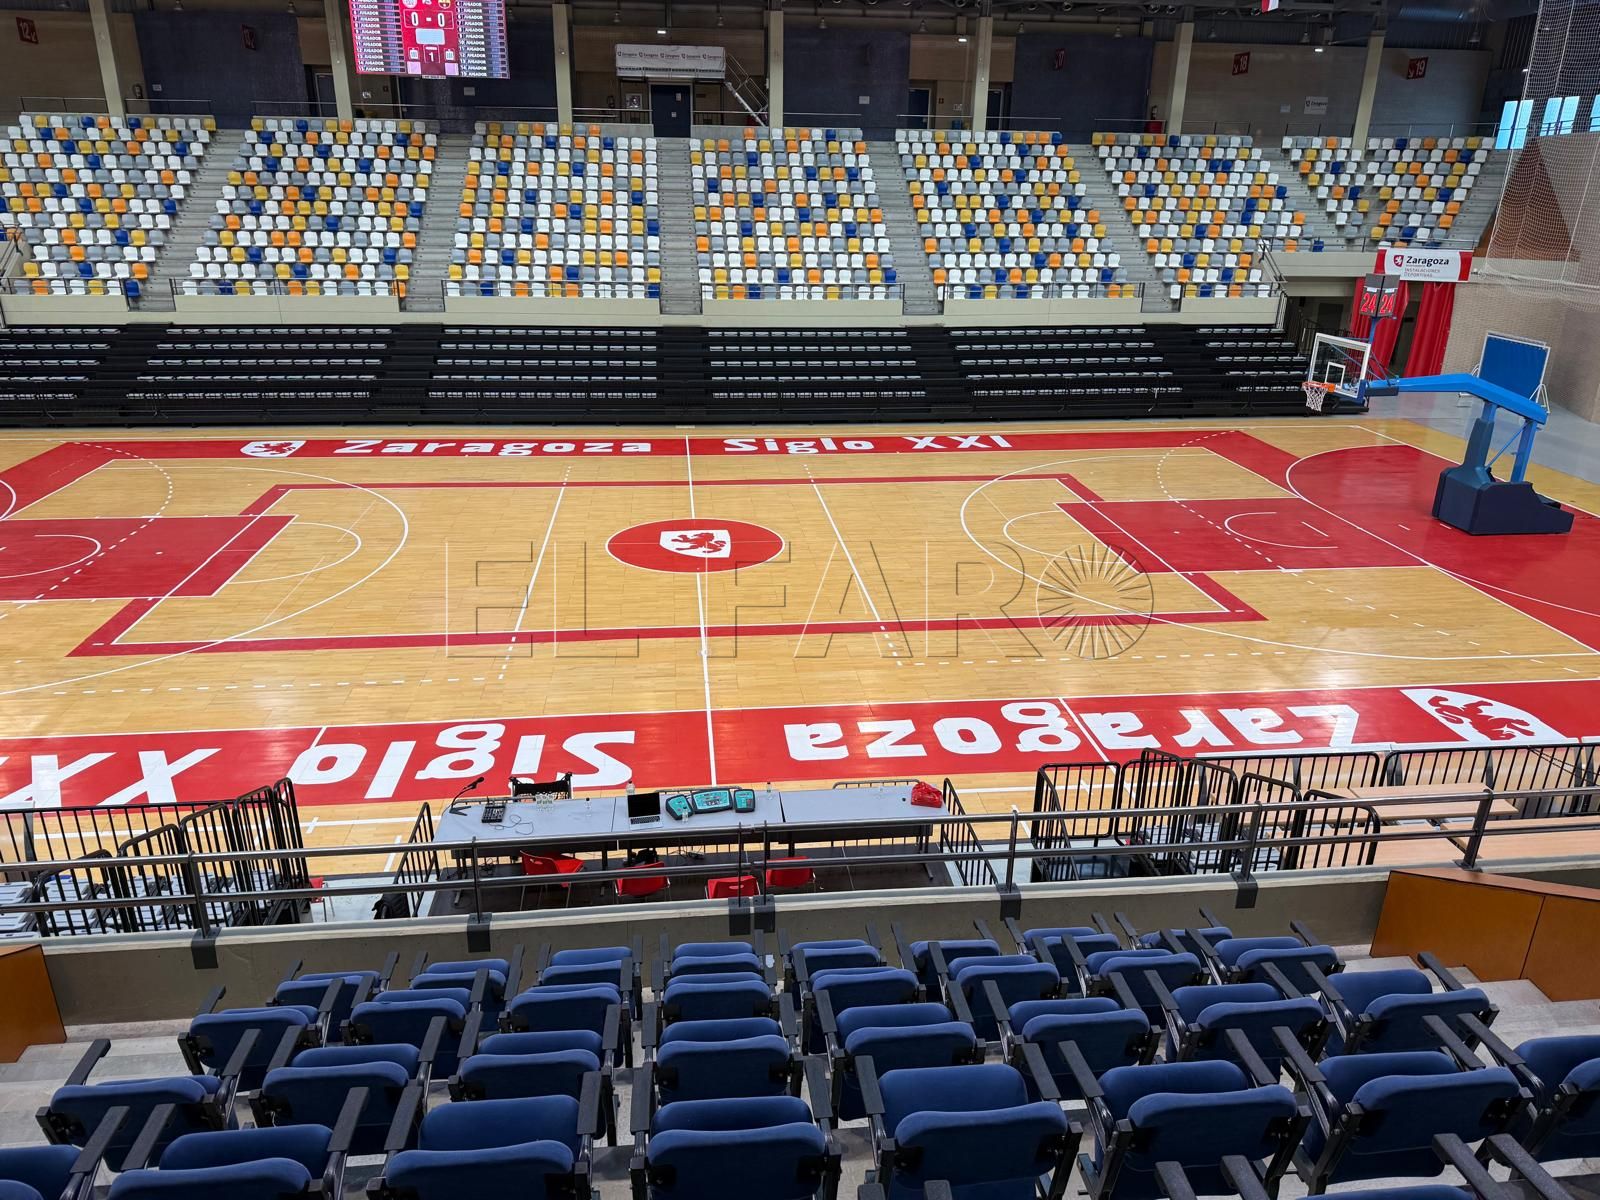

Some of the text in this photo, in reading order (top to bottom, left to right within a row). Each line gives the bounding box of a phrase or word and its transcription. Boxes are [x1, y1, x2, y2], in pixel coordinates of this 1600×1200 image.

[411, 12, 418, 26] 0
[438, 13, 445, 27] 0
[429, 52, 434, 61] 1
[1416, 60, 1425, 75] 19
[1406, 256, 1449, 267] Zaragoza
[1361, 293, 1377, 313] 24
[1380, 294, 1394, 313] 24
[334, 435, 1012, 456] Zaragoza Siglo XXI
[784, 701, 1360, 761] Zaragoza
[285, 723, 636, 799] Siglo
